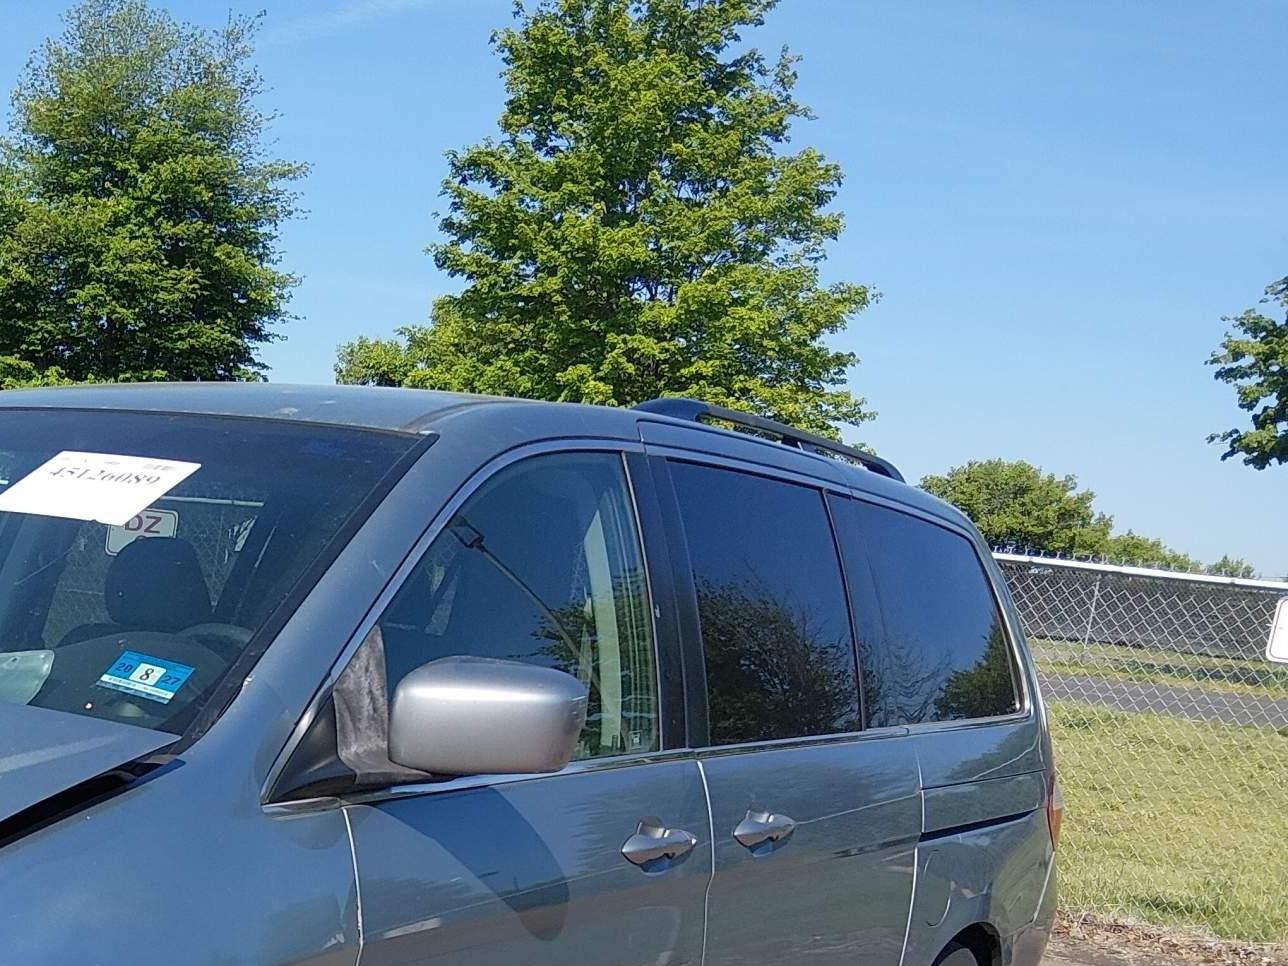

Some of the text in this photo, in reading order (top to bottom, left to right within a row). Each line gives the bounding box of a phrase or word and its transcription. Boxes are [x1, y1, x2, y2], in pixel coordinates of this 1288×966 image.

[49, 466, 161, 484] 45126089
[124, 513, 162, 533] DZ
[115, 662, 181, 686] 20 8 27
